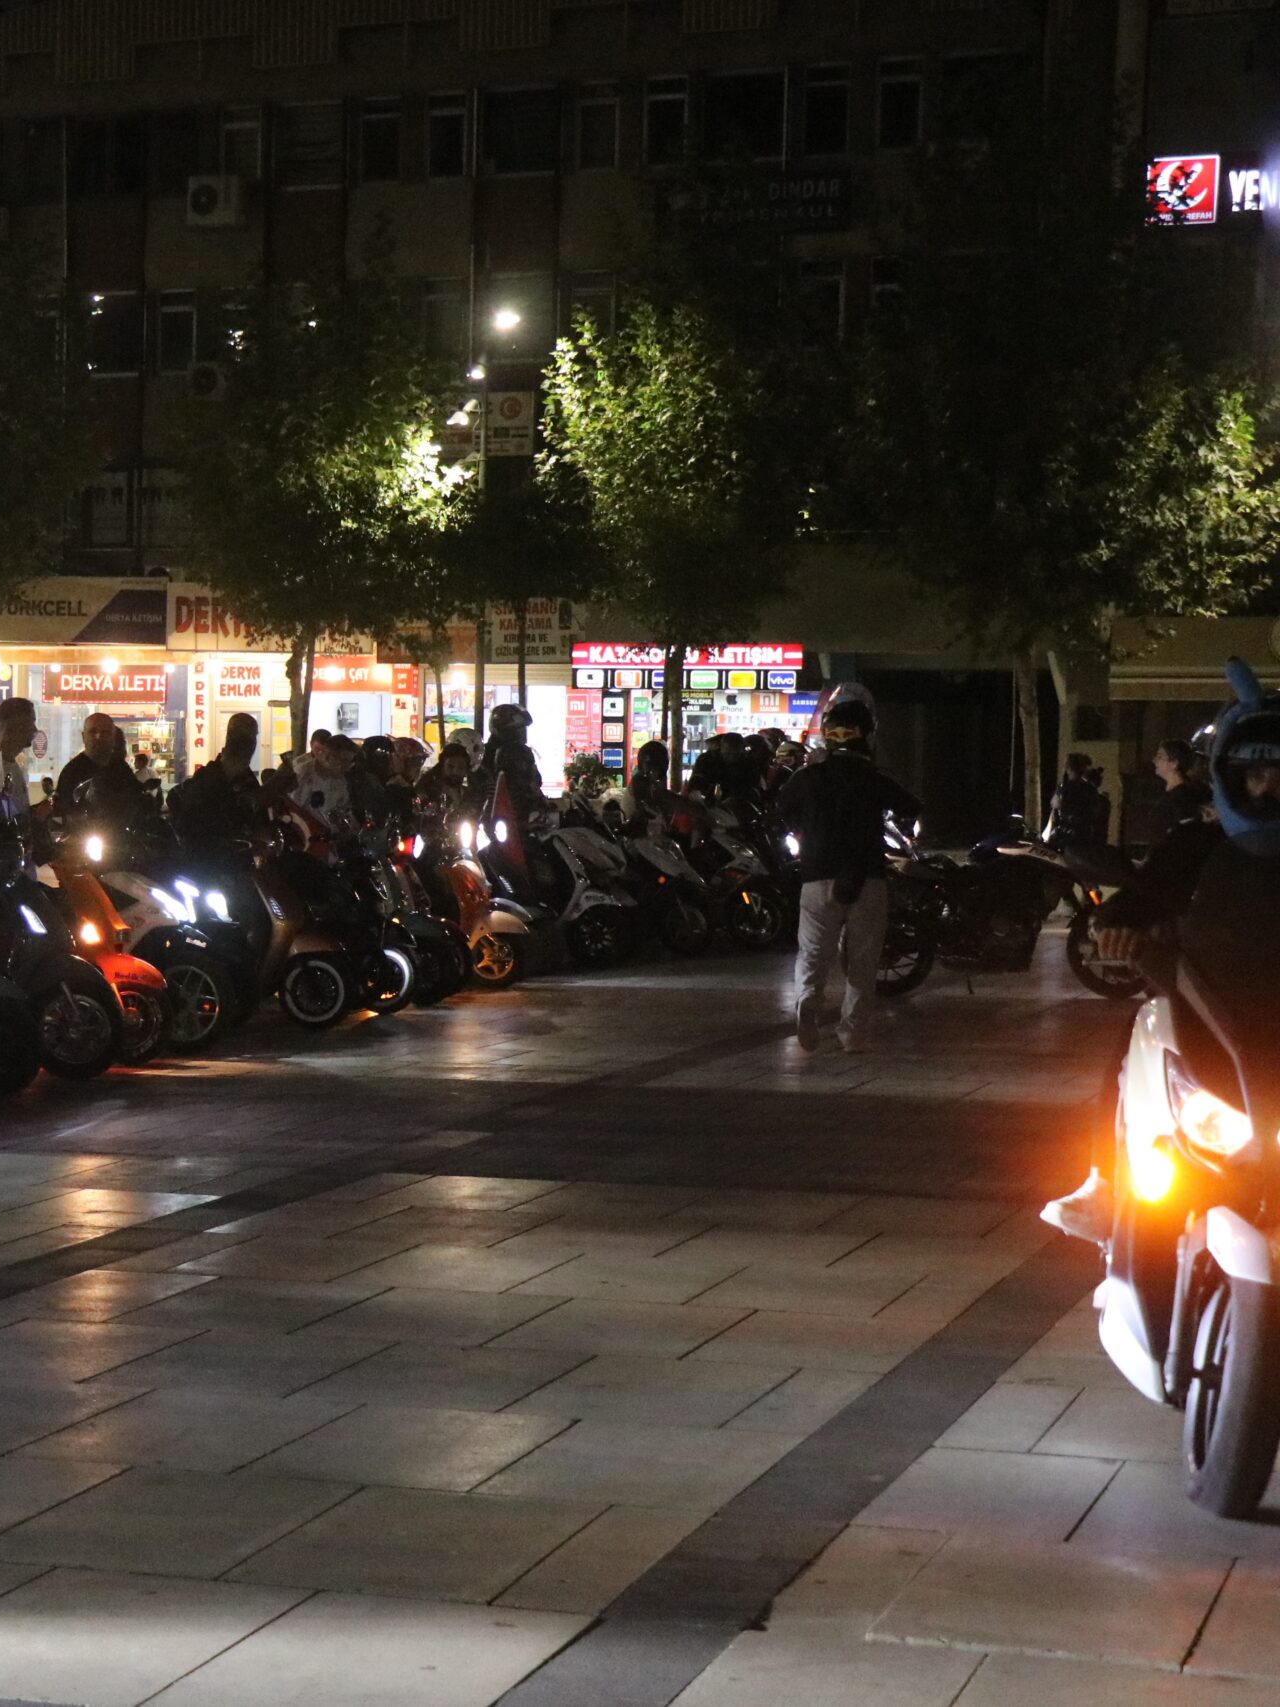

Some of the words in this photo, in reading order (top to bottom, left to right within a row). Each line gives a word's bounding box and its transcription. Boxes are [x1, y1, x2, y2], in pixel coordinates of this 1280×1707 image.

[222, 666, 260, 680] DERYA
[349, 667, 369, 683] ÇAY
[61, 674, 113, 691] DERYA
[770, 676, 794, 686] vivo
[220, 684, 261, 697] EMLAK
[721, 705, 743, 713] iPhone
